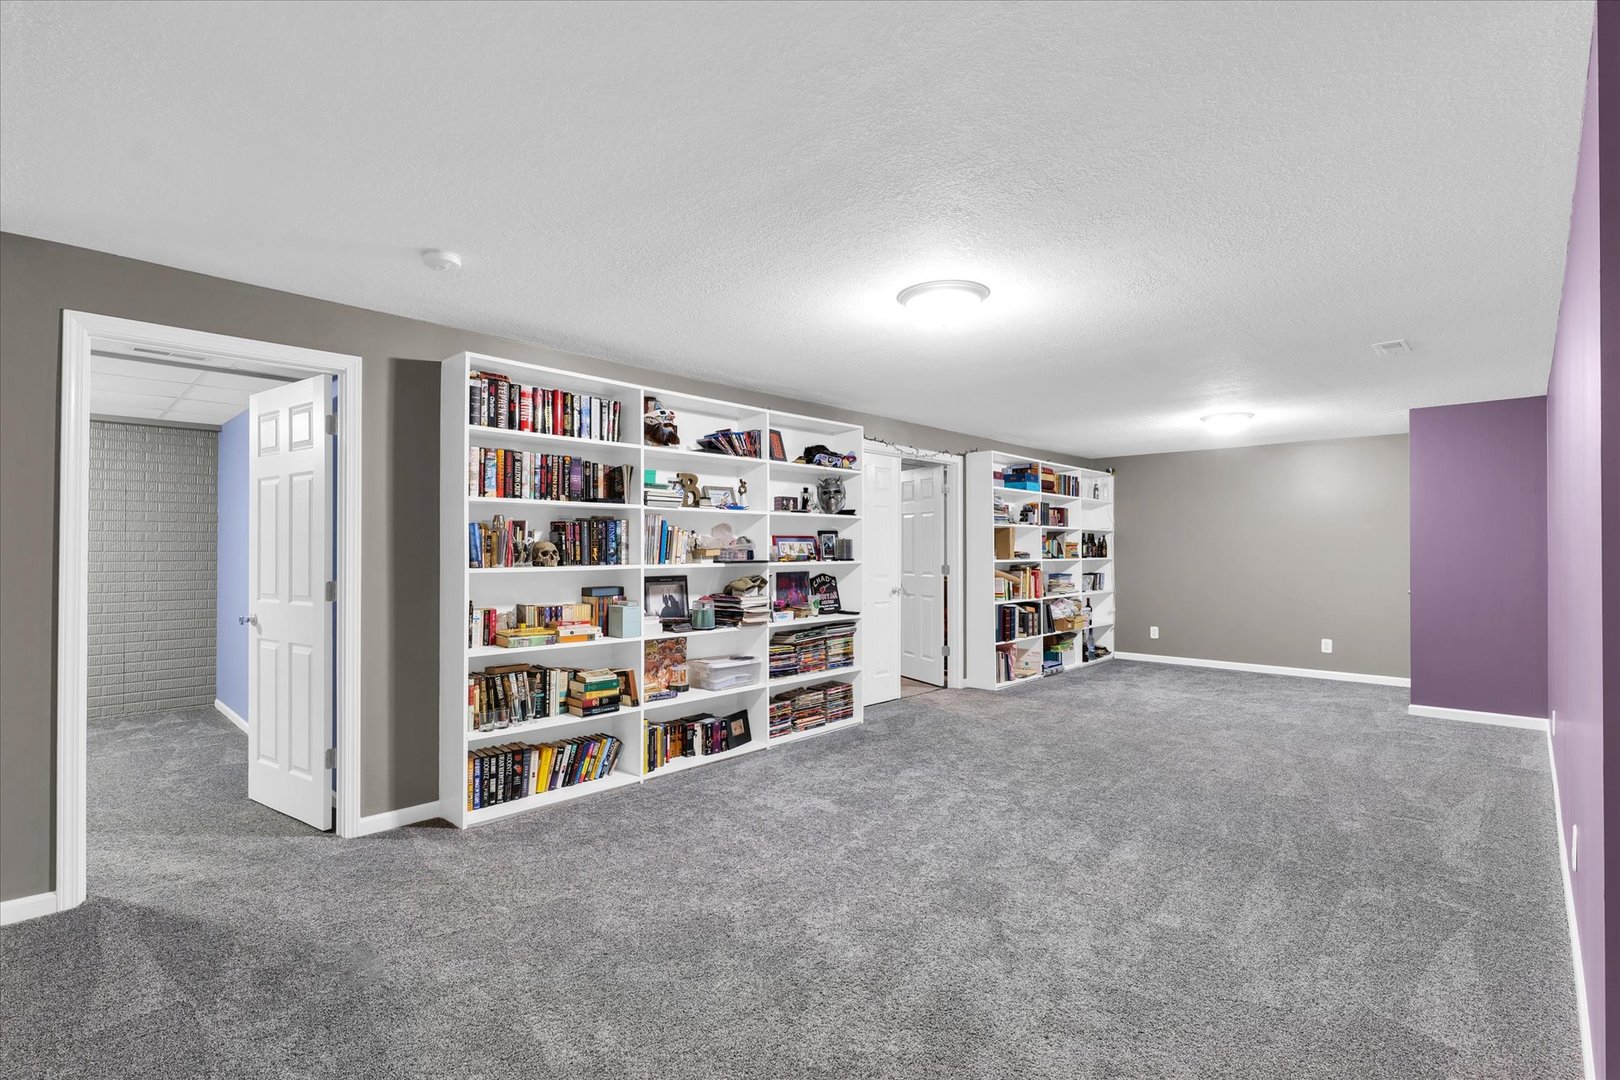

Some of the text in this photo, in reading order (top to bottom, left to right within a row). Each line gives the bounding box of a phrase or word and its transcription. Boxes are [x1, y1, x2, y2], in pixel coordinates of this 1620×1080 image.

[498, 381, 507, 428] STEPHEN KIN
[521, 399, 533, 422] KING
[608, 523, 616, 541] KING
[813, 575, 836, 587] CHAD'S
